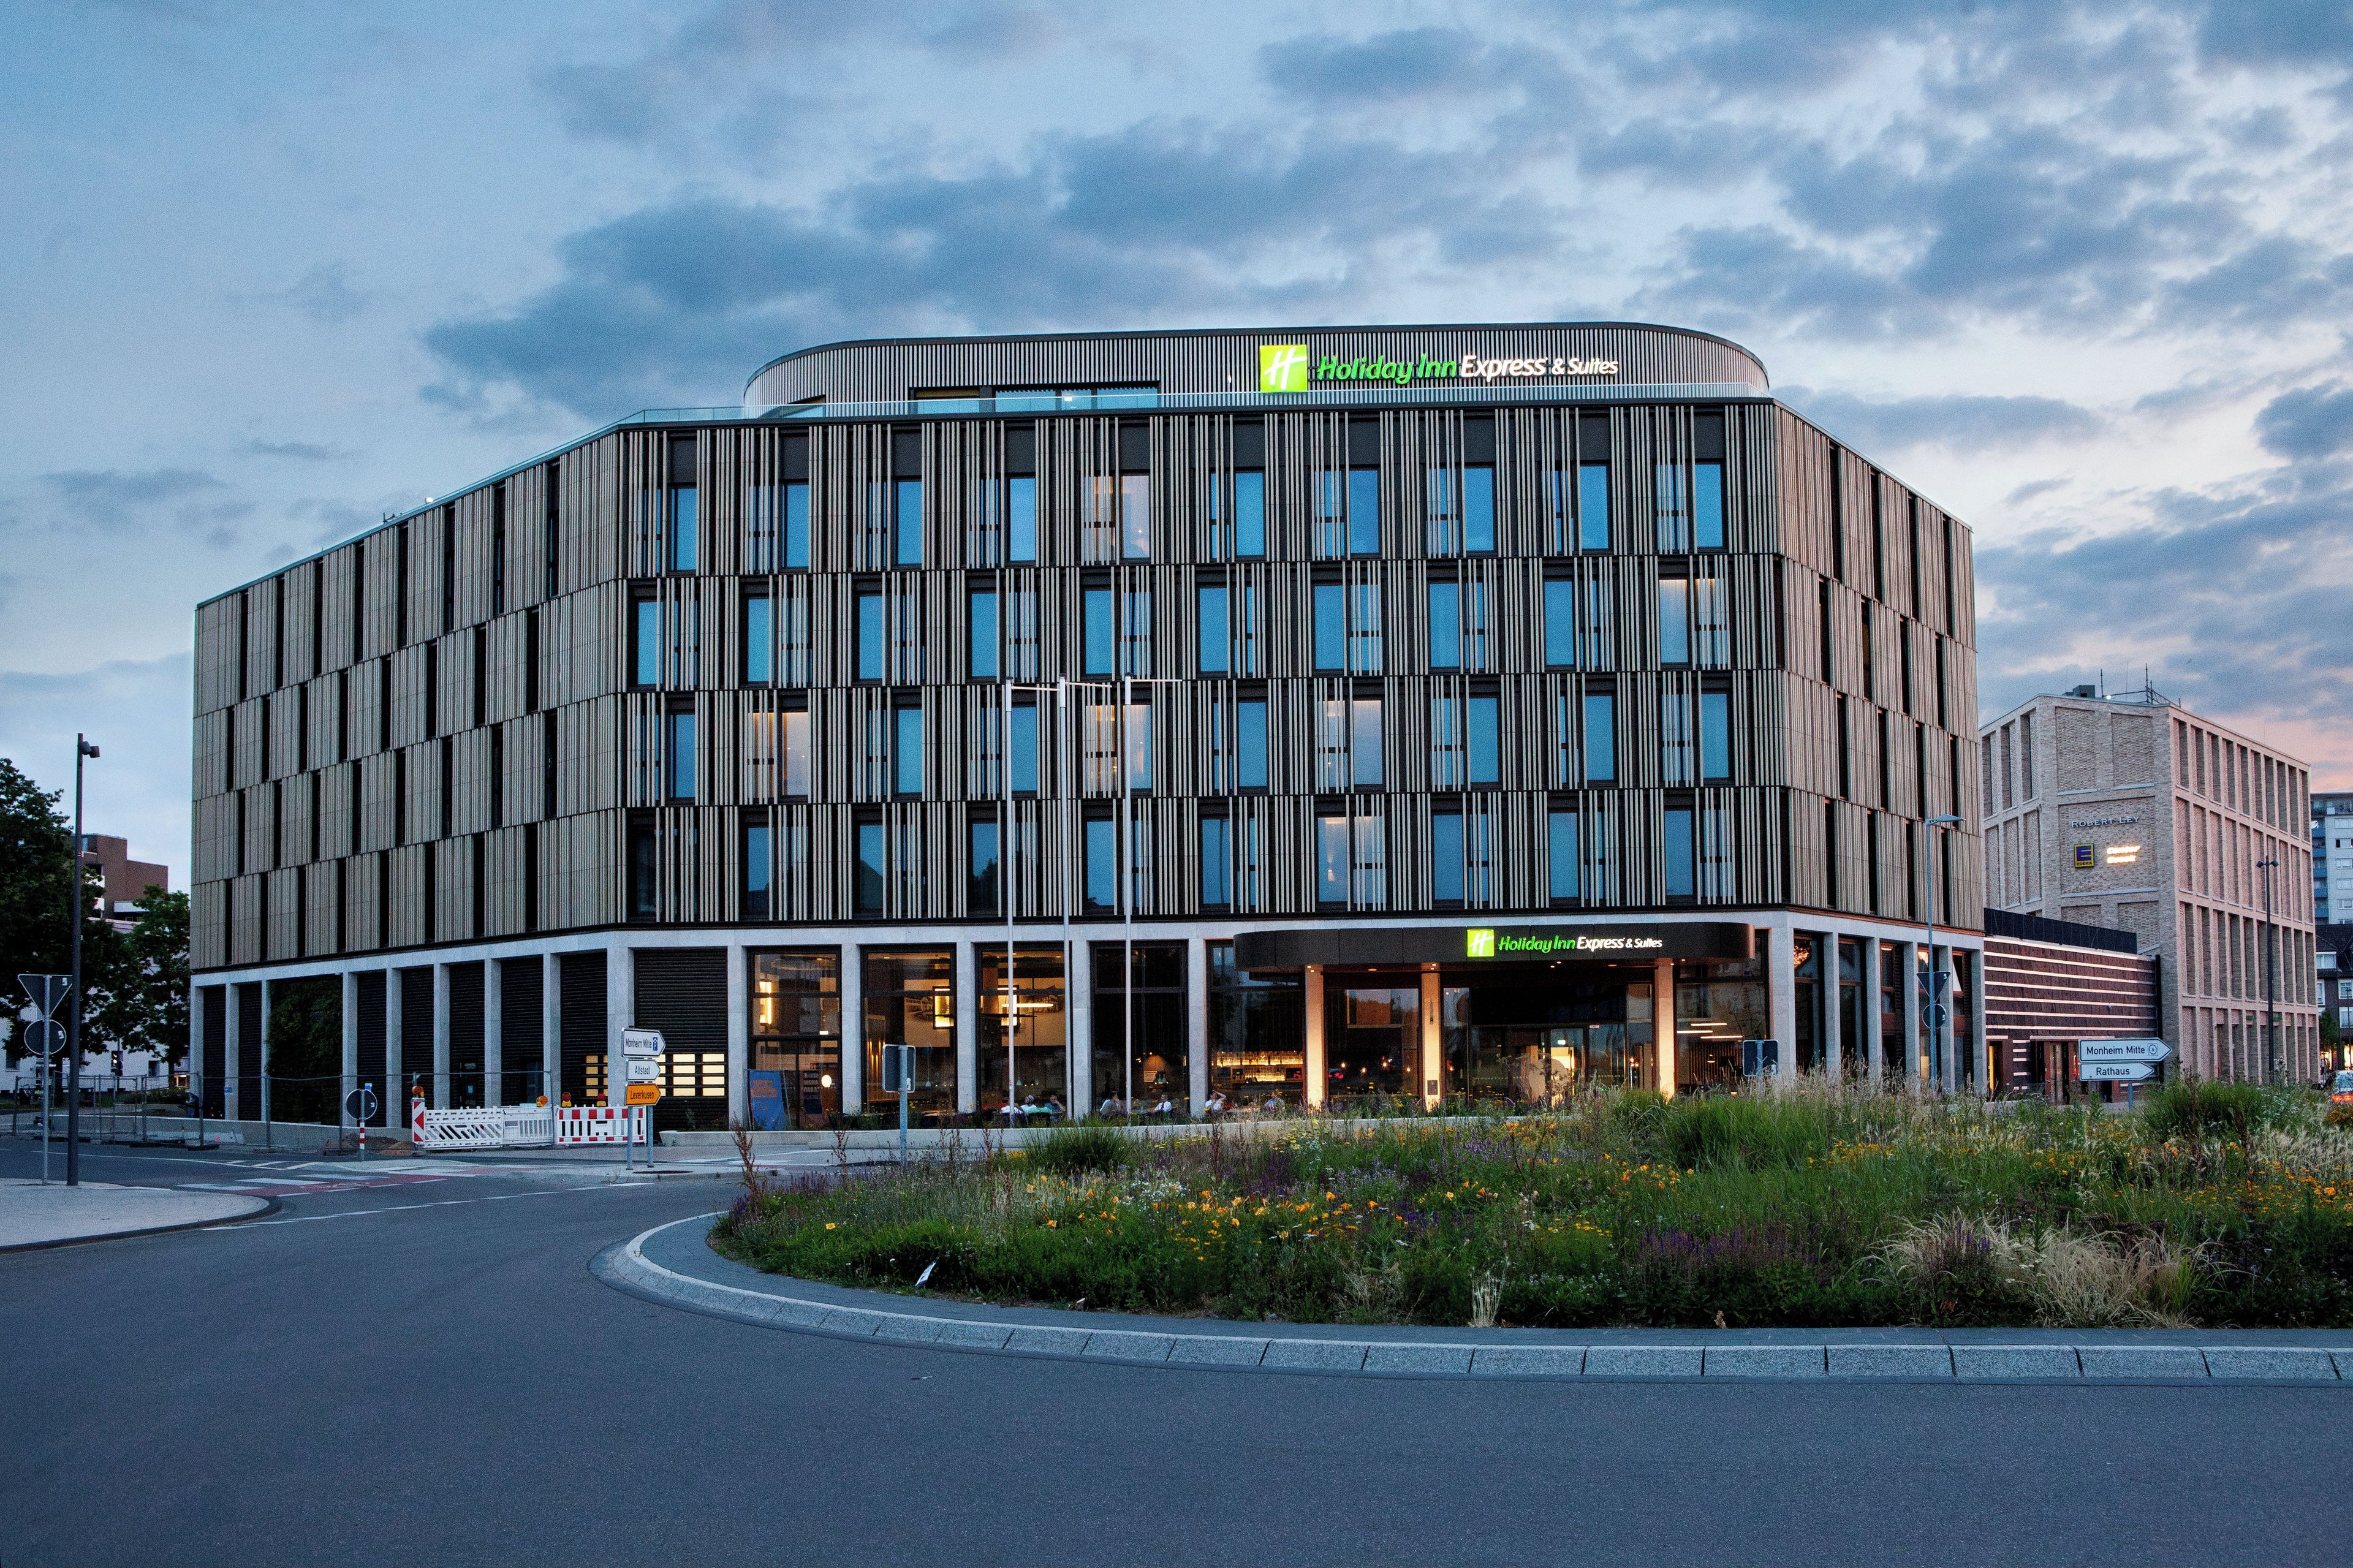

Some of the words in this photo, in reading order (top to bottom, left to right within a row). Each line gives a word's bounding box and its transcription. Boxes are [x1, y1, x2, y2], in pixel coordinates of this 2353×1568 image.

[1317, 355, 1413, 384] Holiday
[1417, 353, 1457, 378] Inn
[1461, 355, 1547, 382] Express
[1552, 358, 1564, 375] &
[1567, 358, 1618, 375] Suites
[1498, 936, 1553, 953] Holiday
[1553, 935, 1575, 950] Inn
[1577, 936, 1624, 952] Express
[1625, 938, 1633, 949] &
[1634, 938, 1662, 949] Suites
[626, 1037, 643, 1048] Monheim
[643, 1039, 652, 1048] Mitte
[2086, 1046, 2123, 1055] Monheim
[2126, 1045, 2145, 1054] Mitte
[635, 1066, 651, 1075] Altstadt
[630, 1090, 654, 1100] Leverkusen
